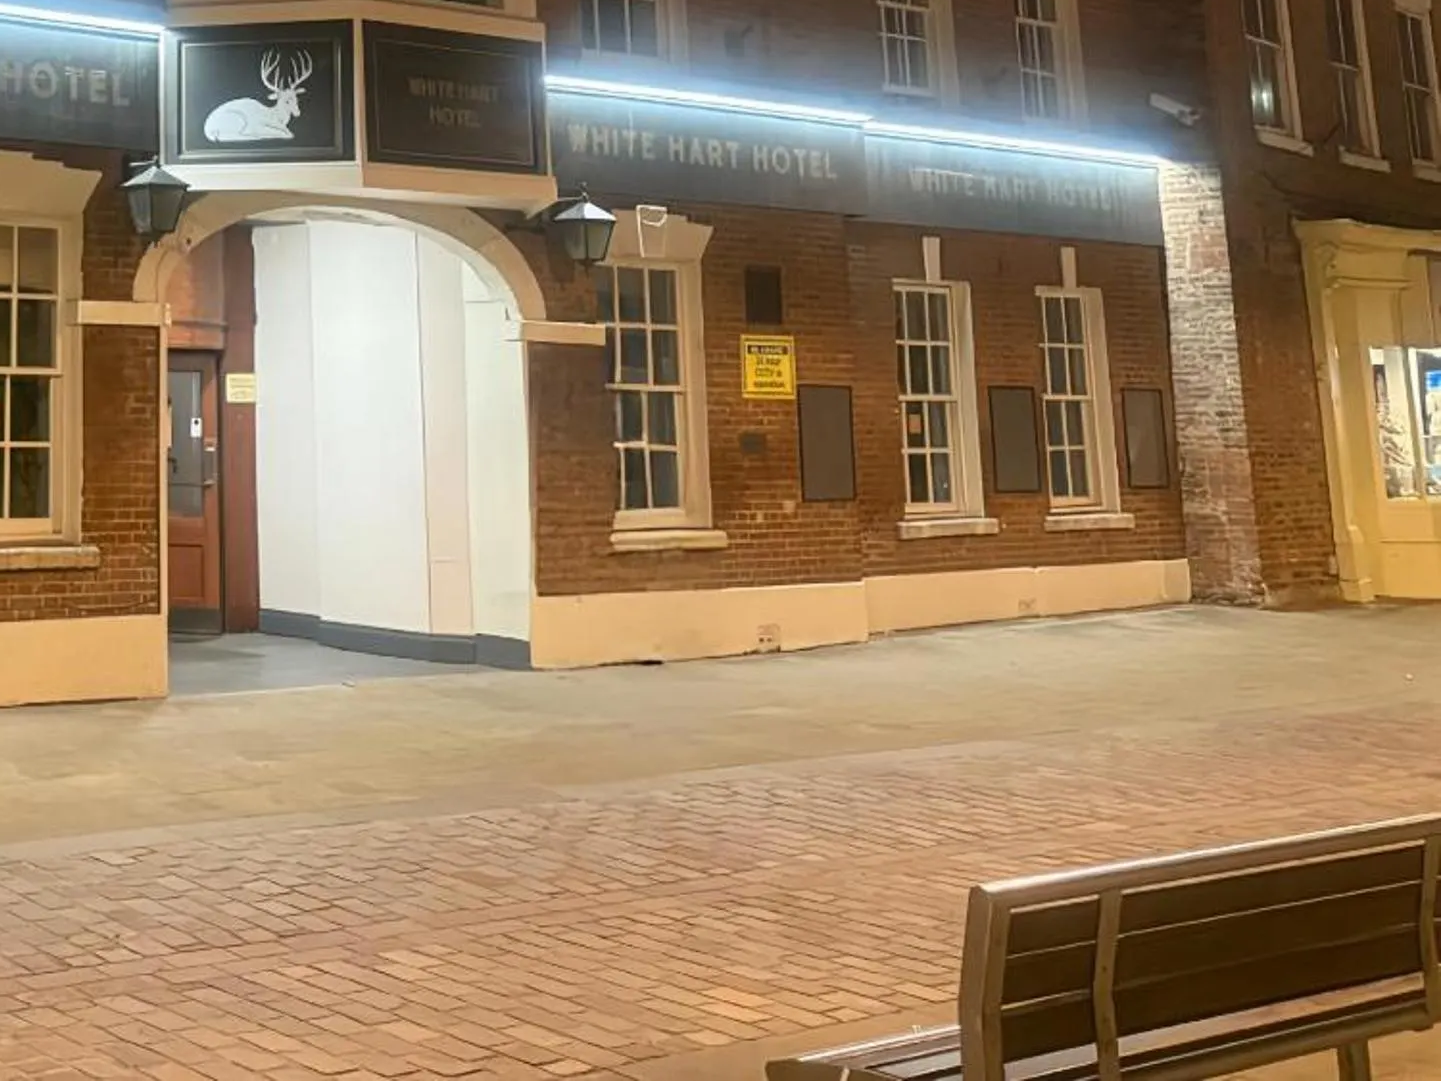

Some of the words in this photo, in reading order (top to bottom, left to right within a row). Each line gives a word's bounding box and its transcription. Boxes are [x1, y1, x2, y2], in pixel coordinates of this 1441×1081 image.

[568, 124, 656, 160] WHITE
[669, 135, 739, 168] HART
[754, 146, 838, 180] HOTEL
